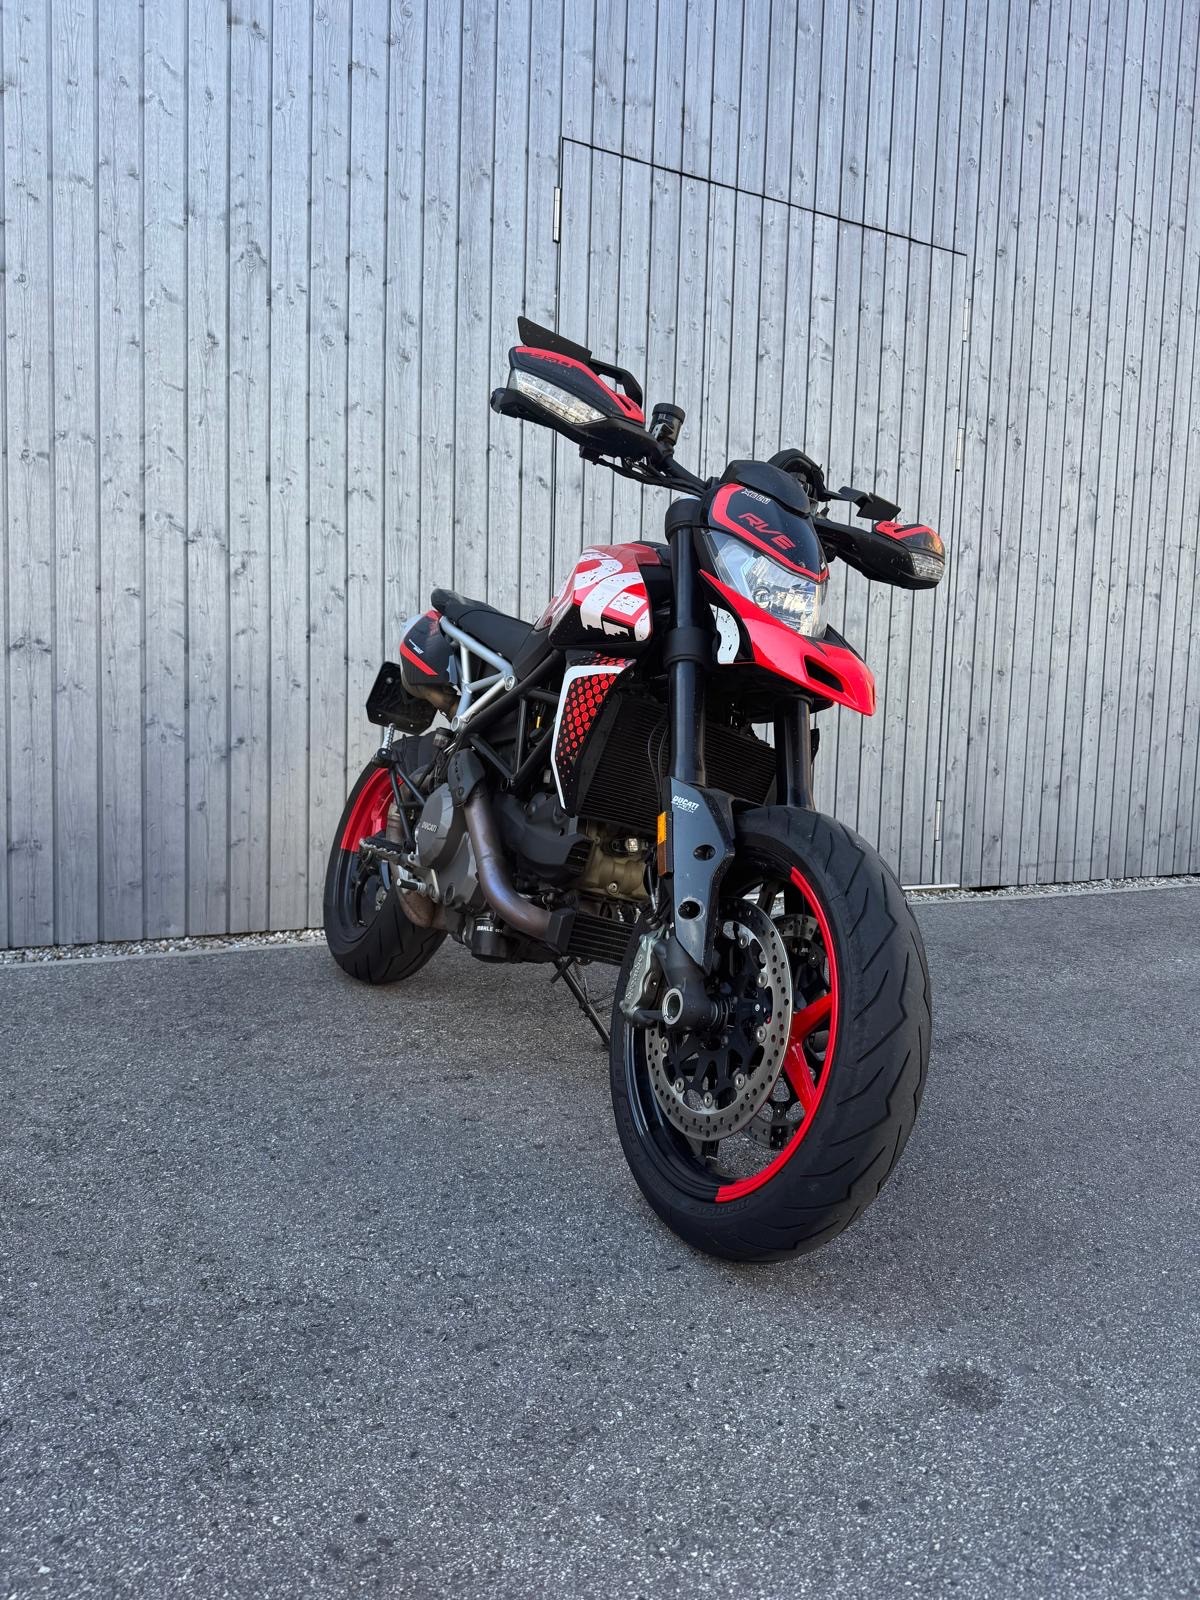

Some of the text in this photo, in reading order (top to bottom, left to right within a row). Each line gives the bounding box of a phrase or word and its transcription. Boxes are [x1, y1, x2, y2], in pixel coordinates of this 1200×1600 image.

[737, 512, 796, 550] RVE
[671, 795, 700, 809] DUCATI
[421, 821, 438, 833] DUCATI
